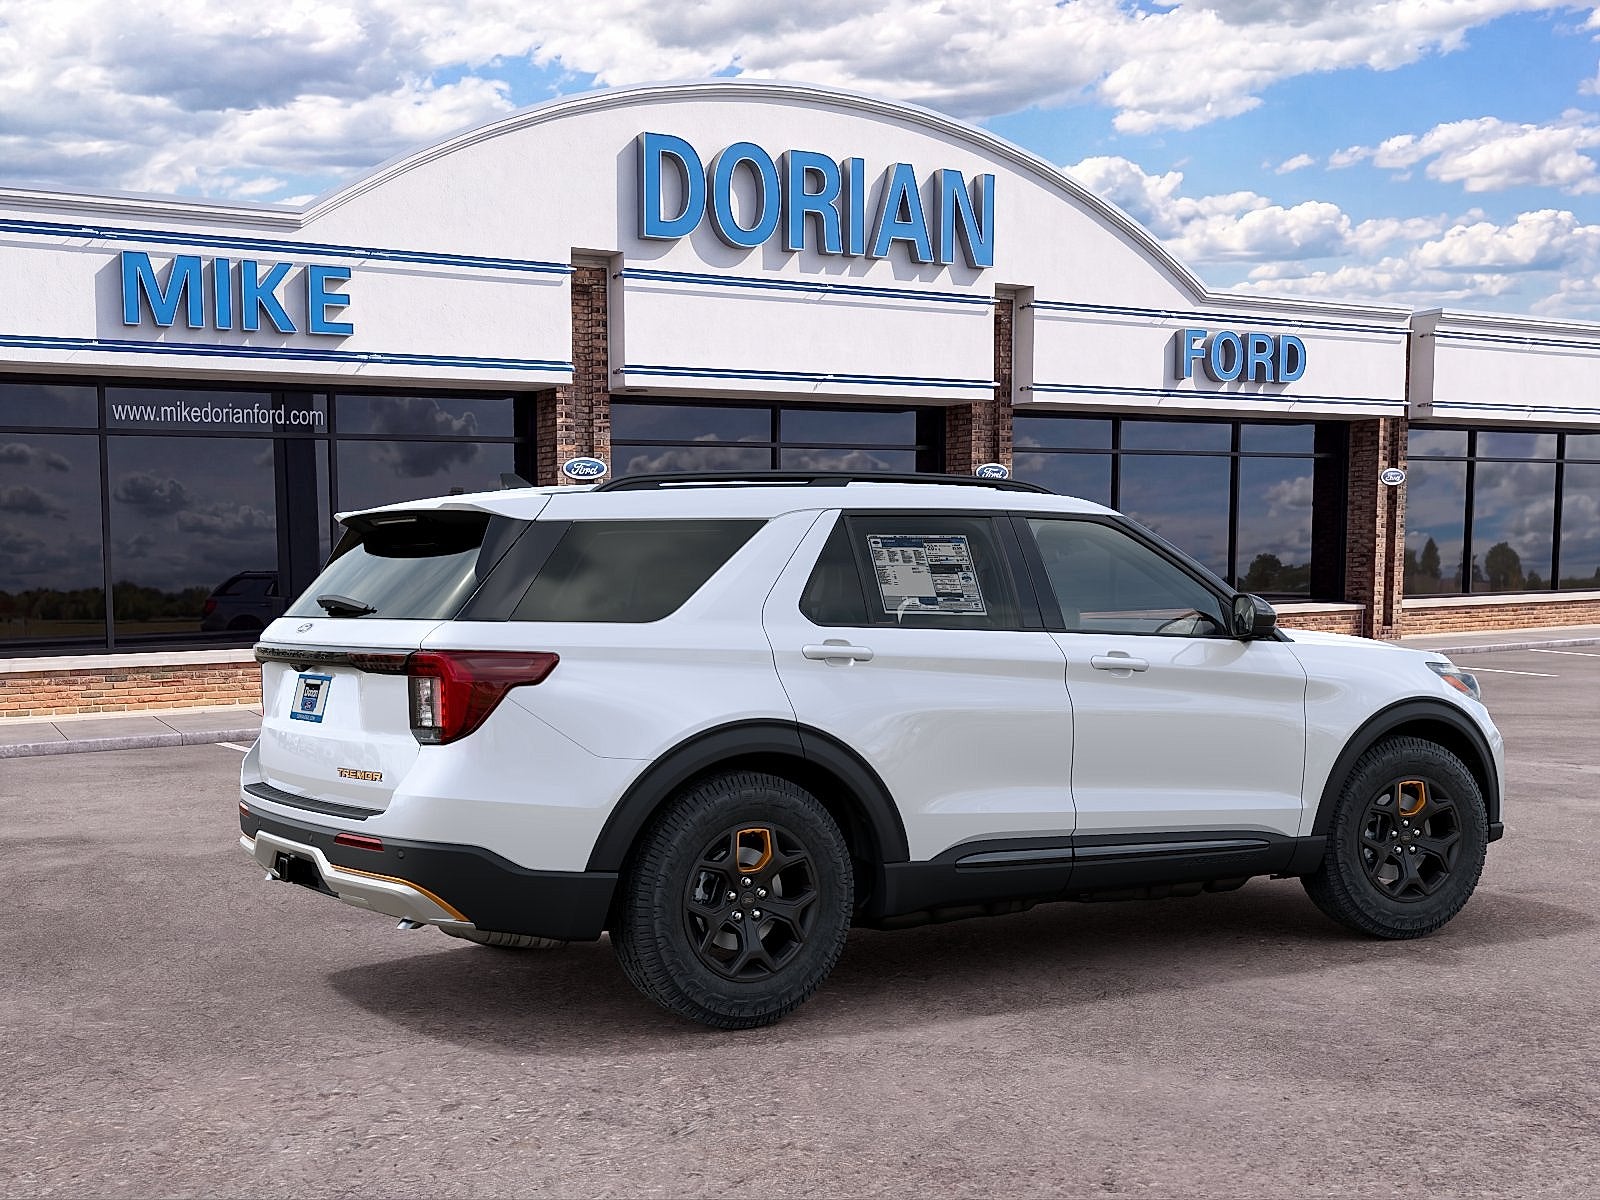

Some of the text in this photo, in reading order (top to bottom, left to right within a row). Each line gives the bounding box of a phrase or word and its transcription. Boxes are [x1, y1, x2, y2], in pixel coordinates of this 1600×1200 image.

[638, 132, 995, 269] DORIAN
[121, 250, 354, 336] MIKE
[1176, 328, 1307, 384] FORD
[111, 401, 325, 426] www.mikedorianford.com
[571, 462, 599, 475] Ford
[337, 767, 383, 782] TREMOR
